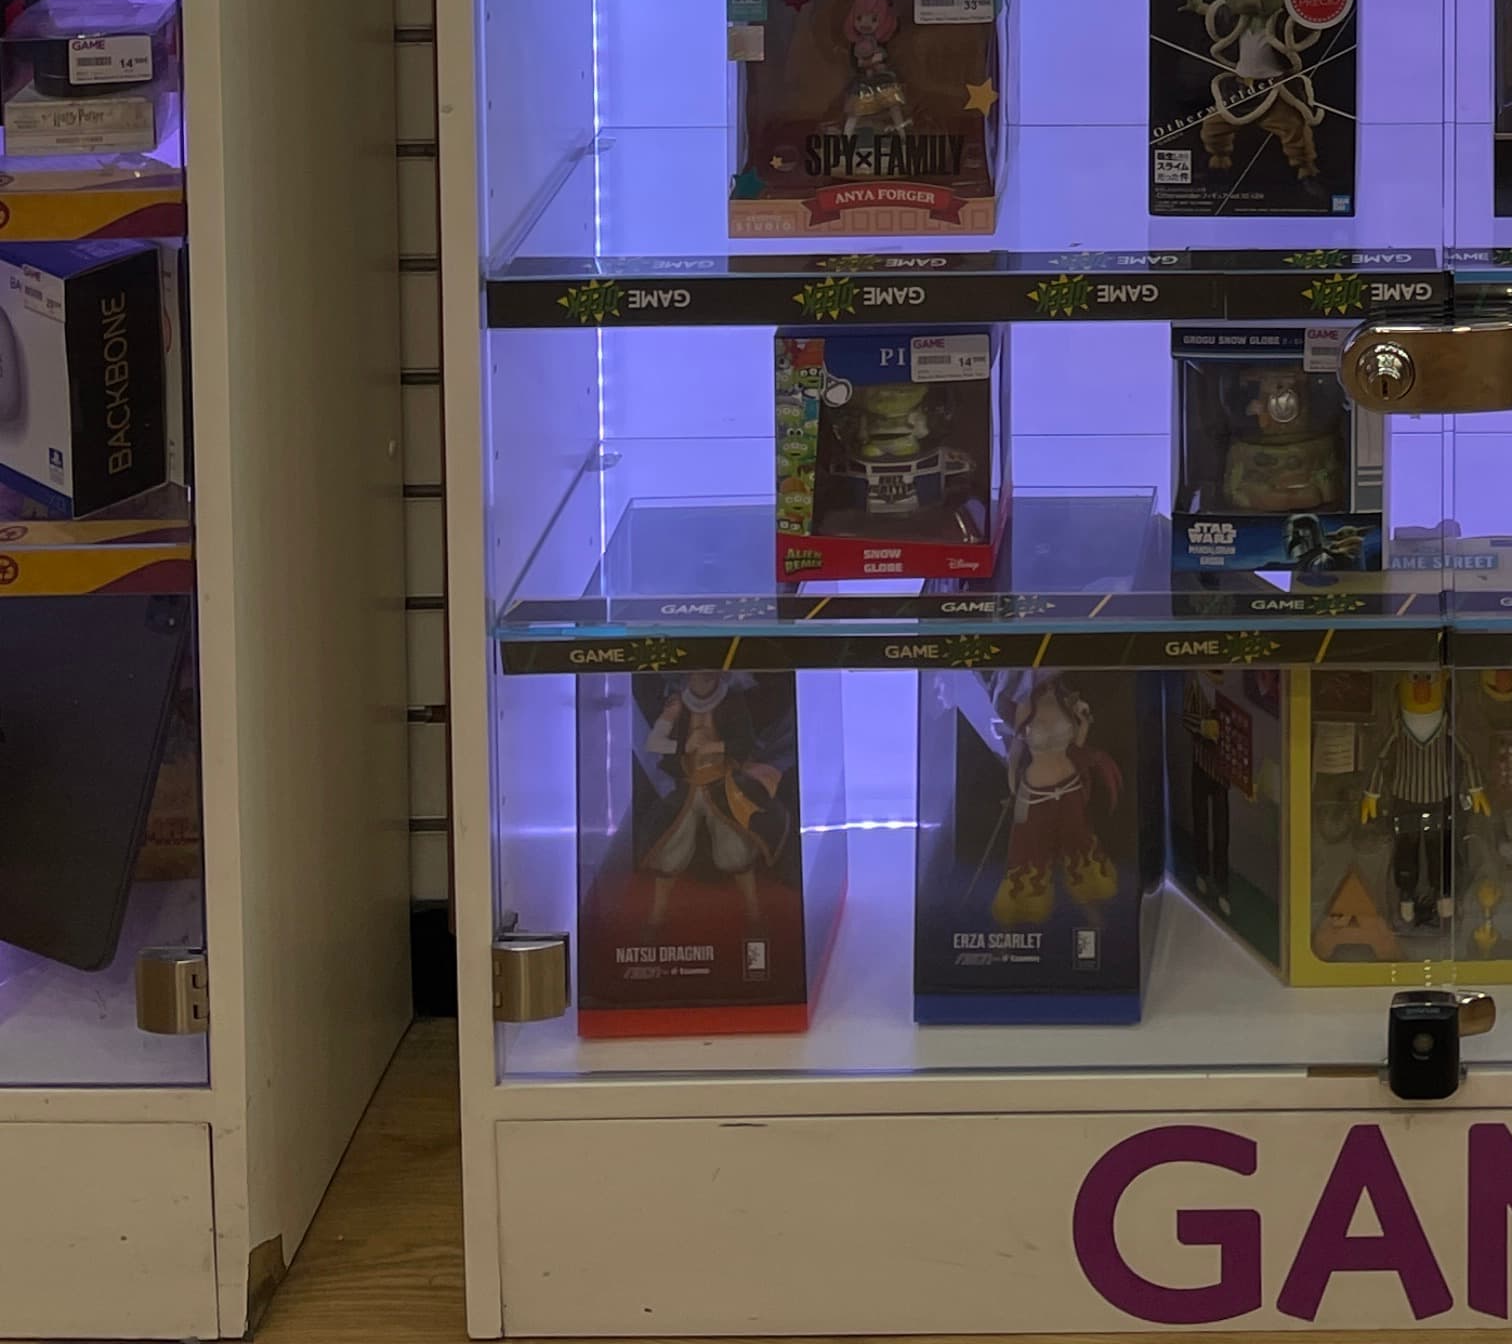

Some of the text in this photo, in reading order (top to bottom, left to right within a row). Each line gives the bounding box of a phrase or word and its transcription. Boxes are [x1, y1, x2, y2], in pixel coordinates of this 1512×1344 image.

[836, 189, 935, 205] ANYA FORGER
[102, 291, 132, 475] BACKBONE
[1166, 641, 1219, 656] GAME
[953, 934, 1042, 950] ERZA SCARLET
[616, 947, 655, 962] NATSU
